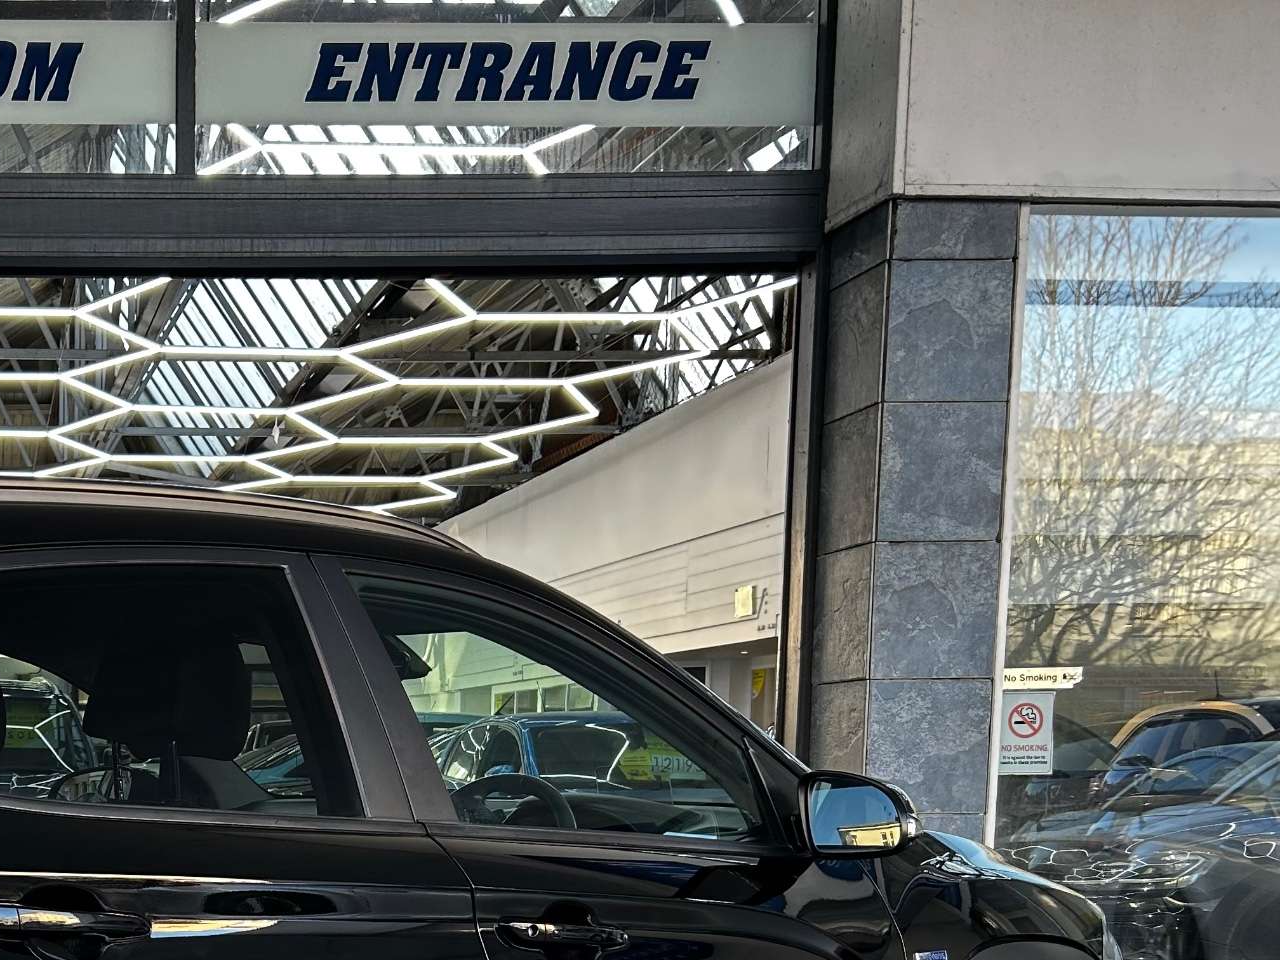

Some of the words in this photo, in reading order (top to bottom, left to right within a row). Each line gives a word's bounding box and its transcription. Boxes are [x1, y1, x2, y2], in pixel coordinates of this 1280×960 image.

[304, 39, 712, 103] ENTRANCE
[1004, 674, 1017, 683] No
[1019, 673, 1058, 683] Smoking
[1001, 744, 1012, 752] NO
[1013, 744, 1048, 752] SMOKING
